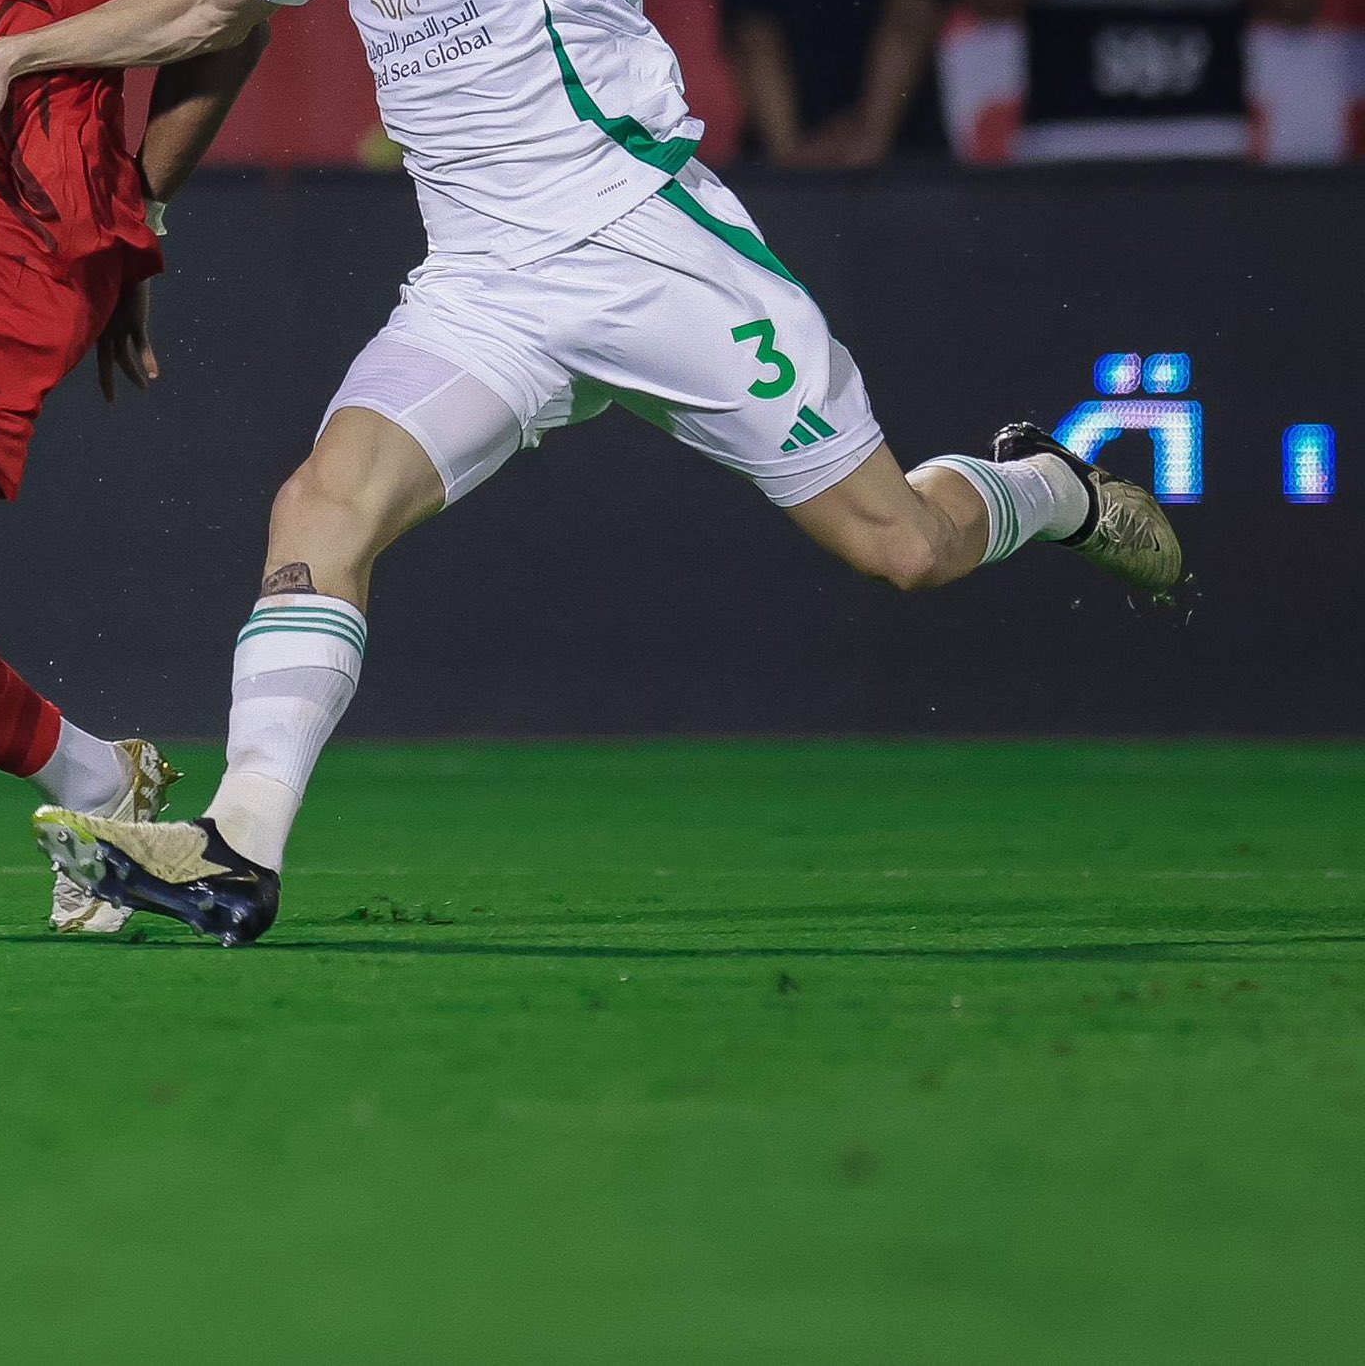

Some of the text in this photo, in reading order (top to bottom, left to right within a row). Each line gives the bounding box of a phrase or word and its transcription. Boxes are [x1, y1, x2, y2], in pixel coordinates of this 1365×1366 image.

[368, 0, 481, 64] البحر الأحمر الدولي
[390, 59, 421, 82] Sea
[424, 25, 494, 68] Global
[730, 318, 797, 400] 3
